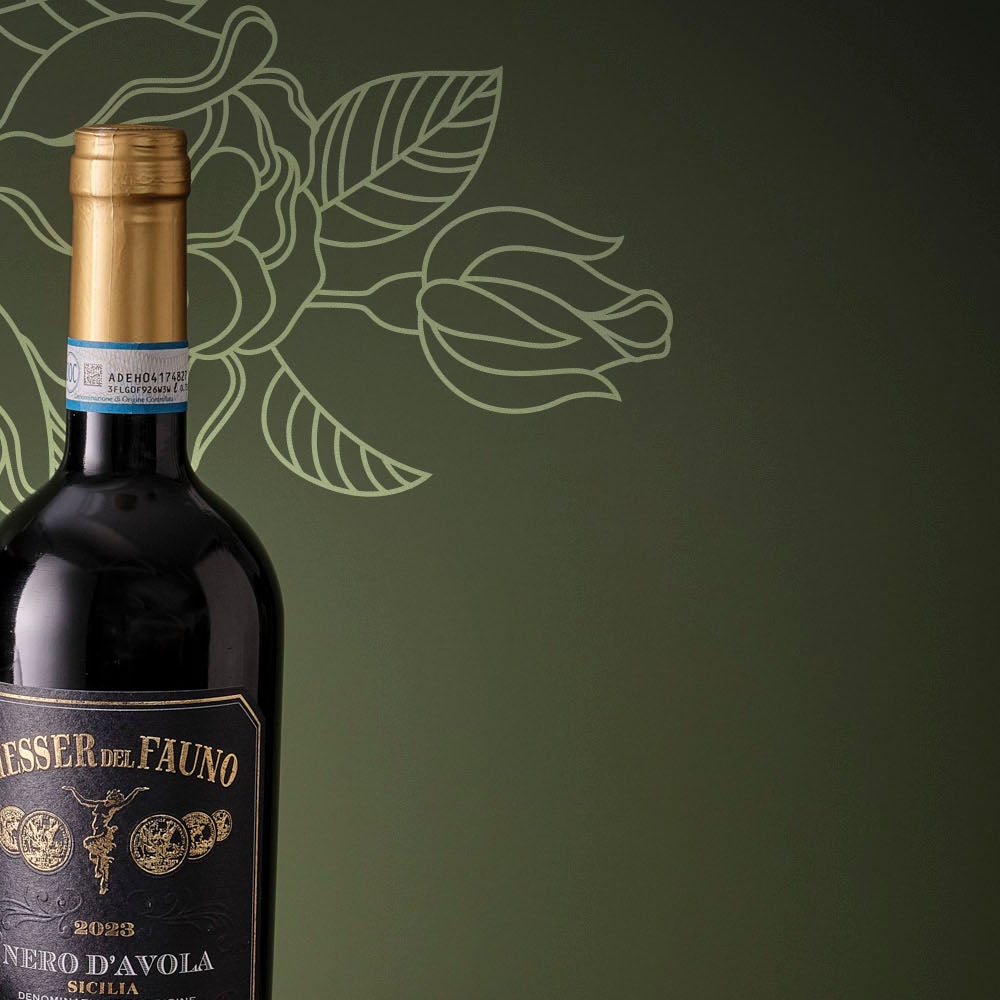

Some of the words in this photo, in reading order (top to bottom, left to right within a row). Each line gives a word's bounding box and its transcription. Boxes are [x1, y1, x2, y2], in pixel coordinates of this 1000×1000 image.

[66, 362, 77, 383] OC
[100, 749, 135, 768] DEL
[137, 735, 238, 787] FAUNO
[74, 920, 135, 937] 2023
[2, 944, 79, 974] NERO
[86, 950, 215, 976] D'AVOLA
[67, 980, 139, 995] SICILIA
